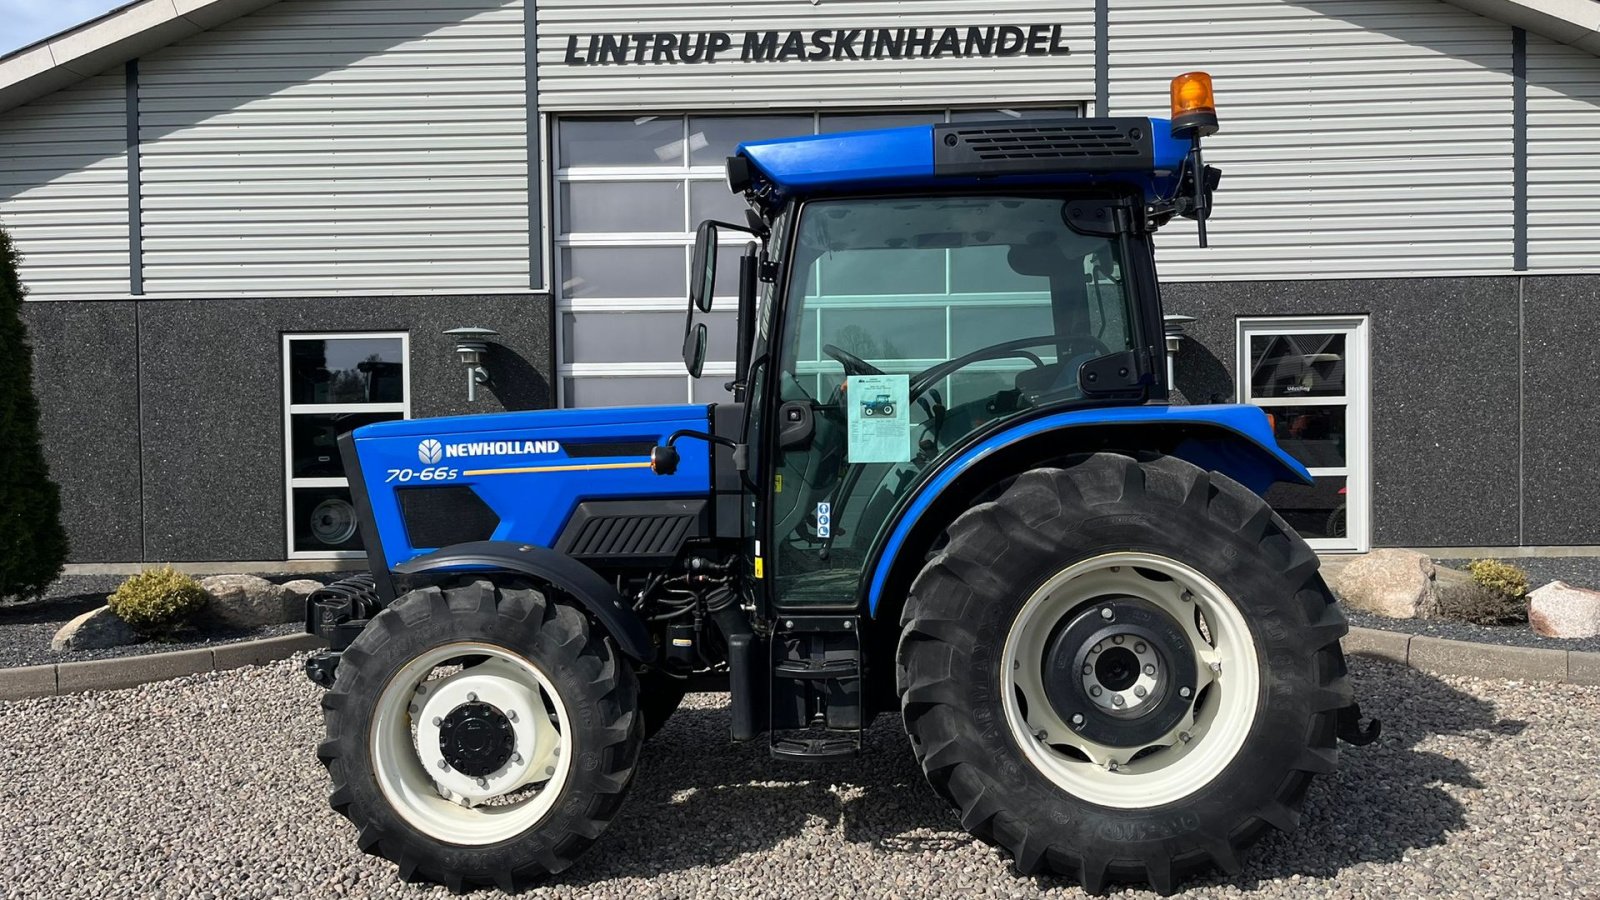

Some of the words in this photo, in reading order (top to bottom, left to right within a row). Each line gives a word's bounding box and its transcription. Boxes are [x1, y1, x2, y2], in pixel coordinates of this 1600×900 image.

[565, 32, 731, 65] LINTRUP
[740, 25, 1070, 61] MASKINHANDEL
[445, 440, 560, 458] NEWHOLLAND
